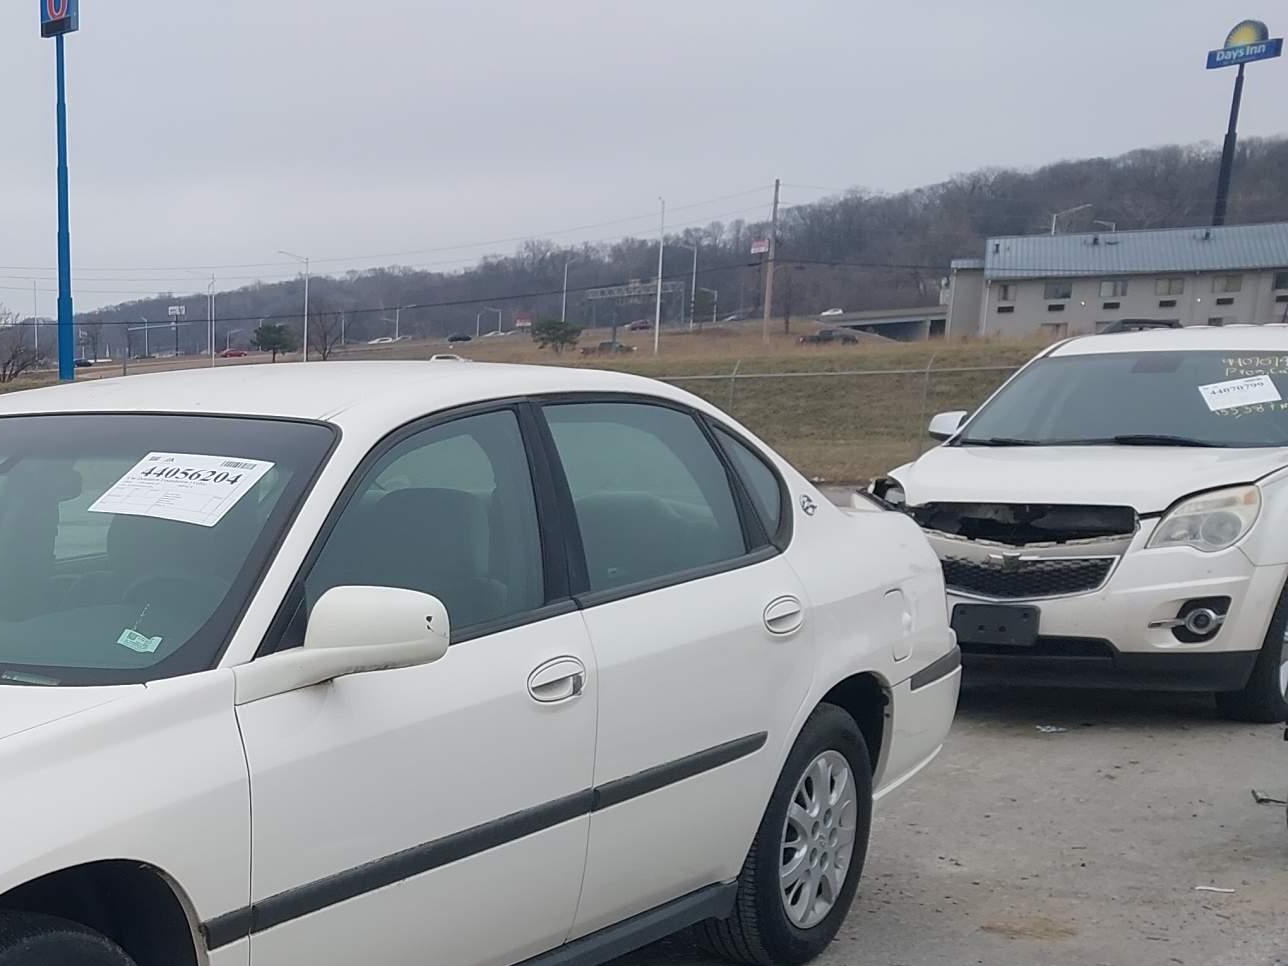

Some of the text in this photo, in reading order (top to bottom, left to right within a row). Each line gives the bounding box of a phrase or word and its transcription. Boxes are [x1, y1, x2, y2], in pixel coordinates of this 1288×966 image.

[1216, 47, 1244, 61] Days
[1246, 44, 1266, 56] Inn
[1210, 381, 1265, 396] 44070799
[140, 465, 244, 486] 44056204
